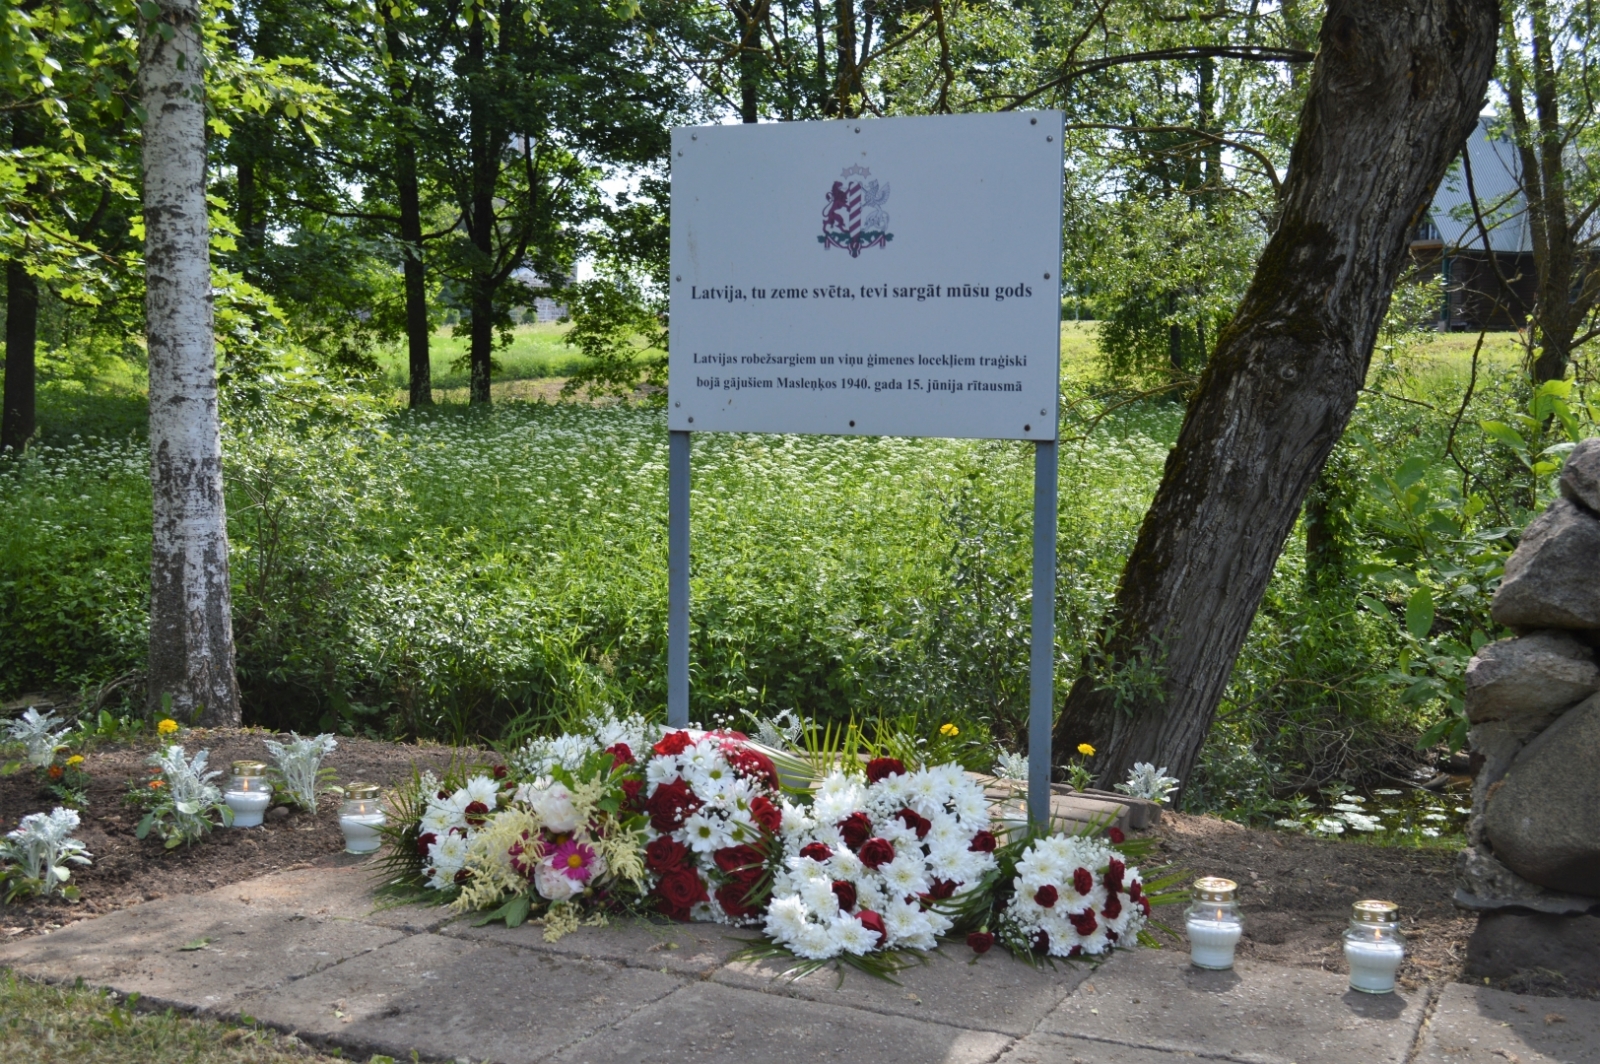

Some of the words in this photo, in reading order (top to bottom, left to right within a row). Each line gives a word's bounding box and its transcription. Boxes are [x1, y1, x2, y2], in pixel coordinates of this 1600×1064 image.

[691, 284, 748, 304] Latvija,
[751, 286, 766, 300] tu
[770, 288, 809, 300] zeme
[812, 284, 856, 300] svēta,
[860, 283, 888, 299] tevi
[892, 283, 942, 302] sargāt
[946, 283, 990, 298] mūsu
[994, 282, 1033, 302] gods
[693, 352, 738, 367] Latvijas
[741, 352, 817, 368] robežsargiem
[819, 356, 835, 365] un
[837, 353, 864, 368] viņu
[866, 353, 915, 368] ģimenes
[918, 353, 976, 369] locekļiem
[979, 354, 1027, 370] traģiski
[696, 376, 721, 391] bojā
[723, 376, 773, 391] gājušiem
[776, 376, 838, 392] Masleņķos
[841, 377, 871, 390] 1940.
[874, 378, 903, 393] gada
[907, 378, 924, 391] 15.
[925, 378, 964, 394] jūnija
[967, 380, 1023, 392] rītausmā
